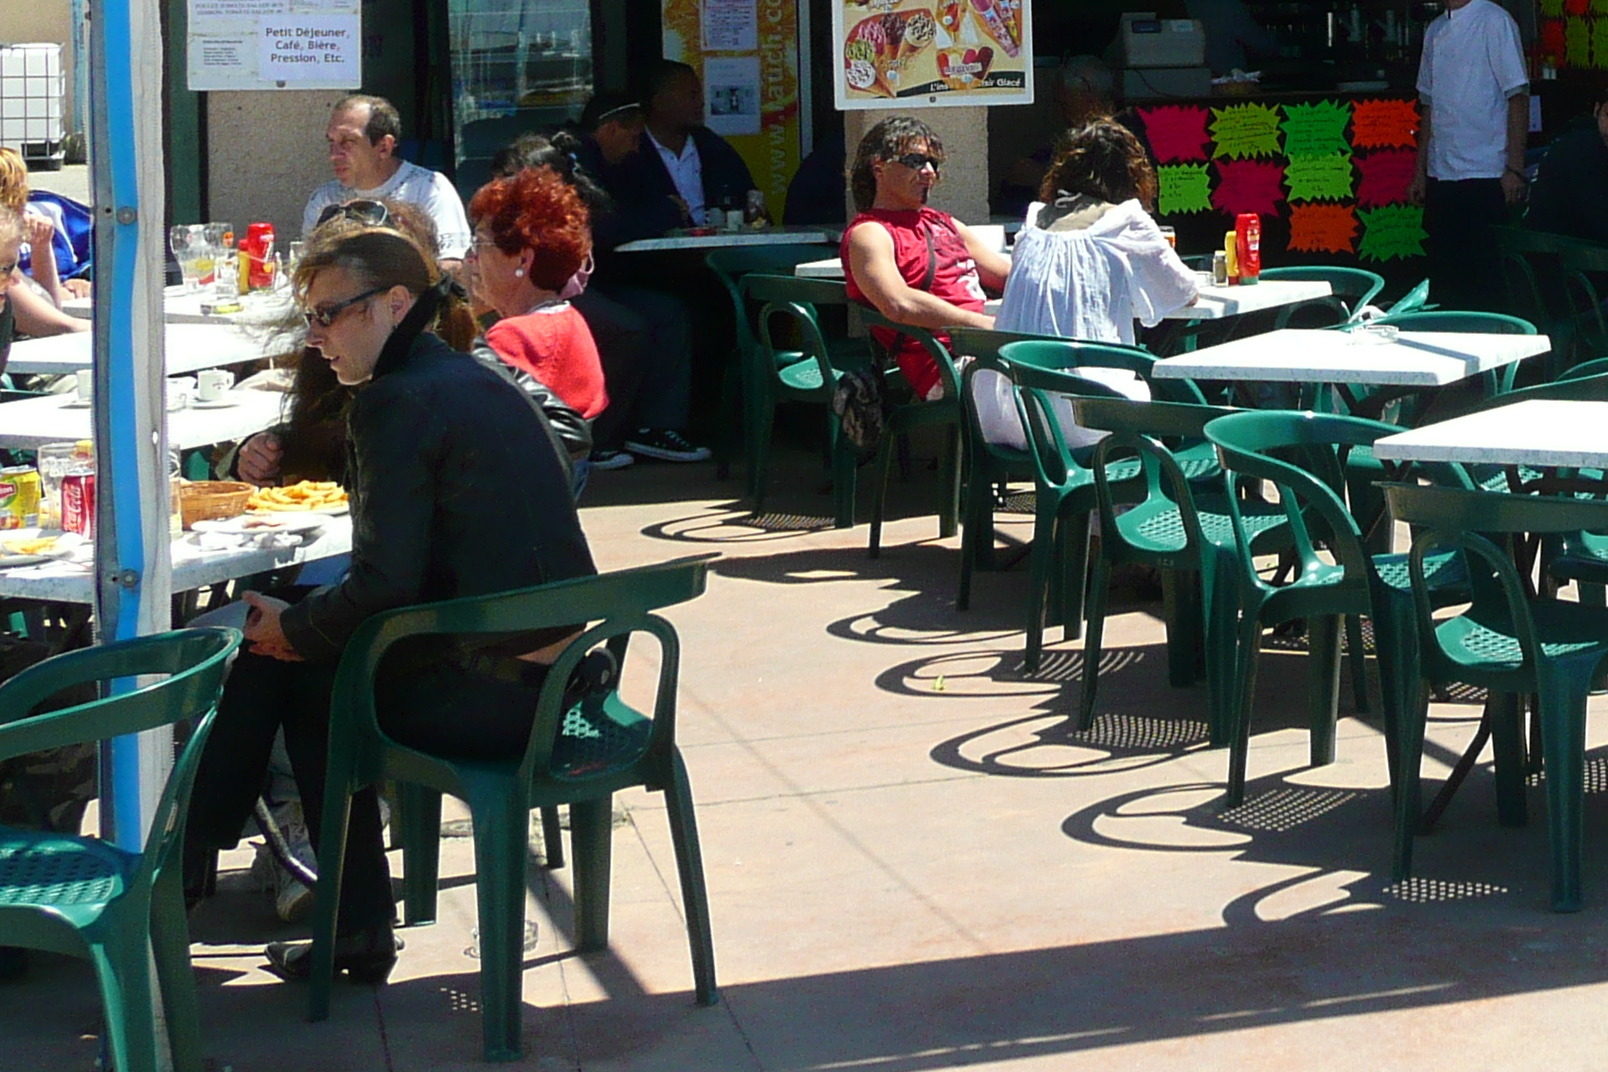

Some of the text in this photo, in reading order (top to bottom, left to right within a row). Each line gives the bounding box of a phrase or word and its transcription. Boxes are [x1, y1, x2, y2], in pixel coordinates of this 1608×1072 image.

[265, 27, 350, 40] Petit Déjeuner,
[275, 40, 341, 51] Café, Bière,
[270, 53, 345, 64] Pression, Etc.
